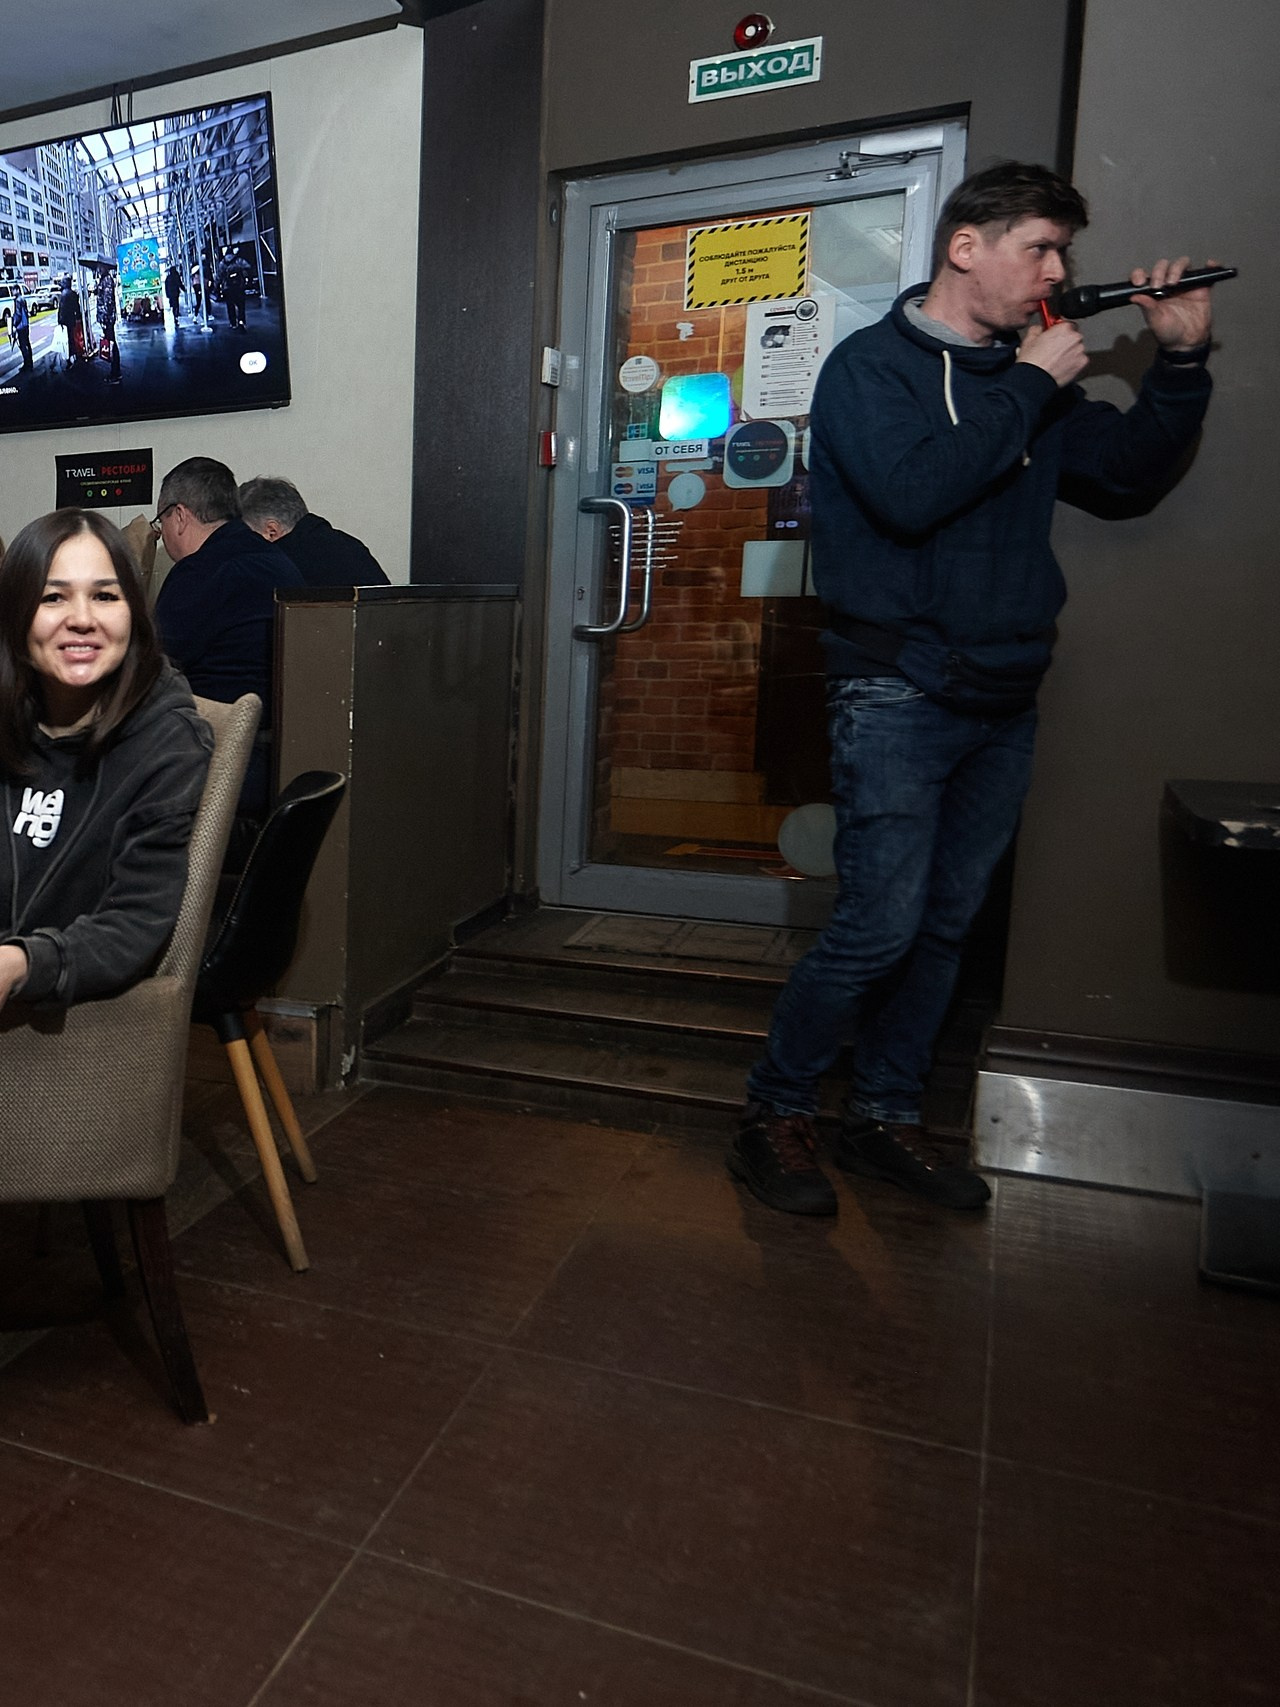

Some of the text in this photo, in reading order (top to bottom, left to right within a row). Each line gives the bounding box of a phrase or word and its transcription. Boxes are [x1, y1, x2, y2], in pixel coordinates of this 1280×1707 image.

[701, 52, 811, 87] ВЫХОД
[699, 244, 796, 262] СОБЛЮДАЙТЕ ПОЖАЛУЙСТА
[724, 256, 768, 267] ДИСТАНЦИЮ
[721, 277, 737, 285] ДРУГ
[748, 273, 770, 282] ДРУГА
[654, 444, 703, 455] ОТ СЕБЯ
[65, 464, 147, 478] TRAVEL РЕСТОБАР
[637, 467, 655, 475] VISA
